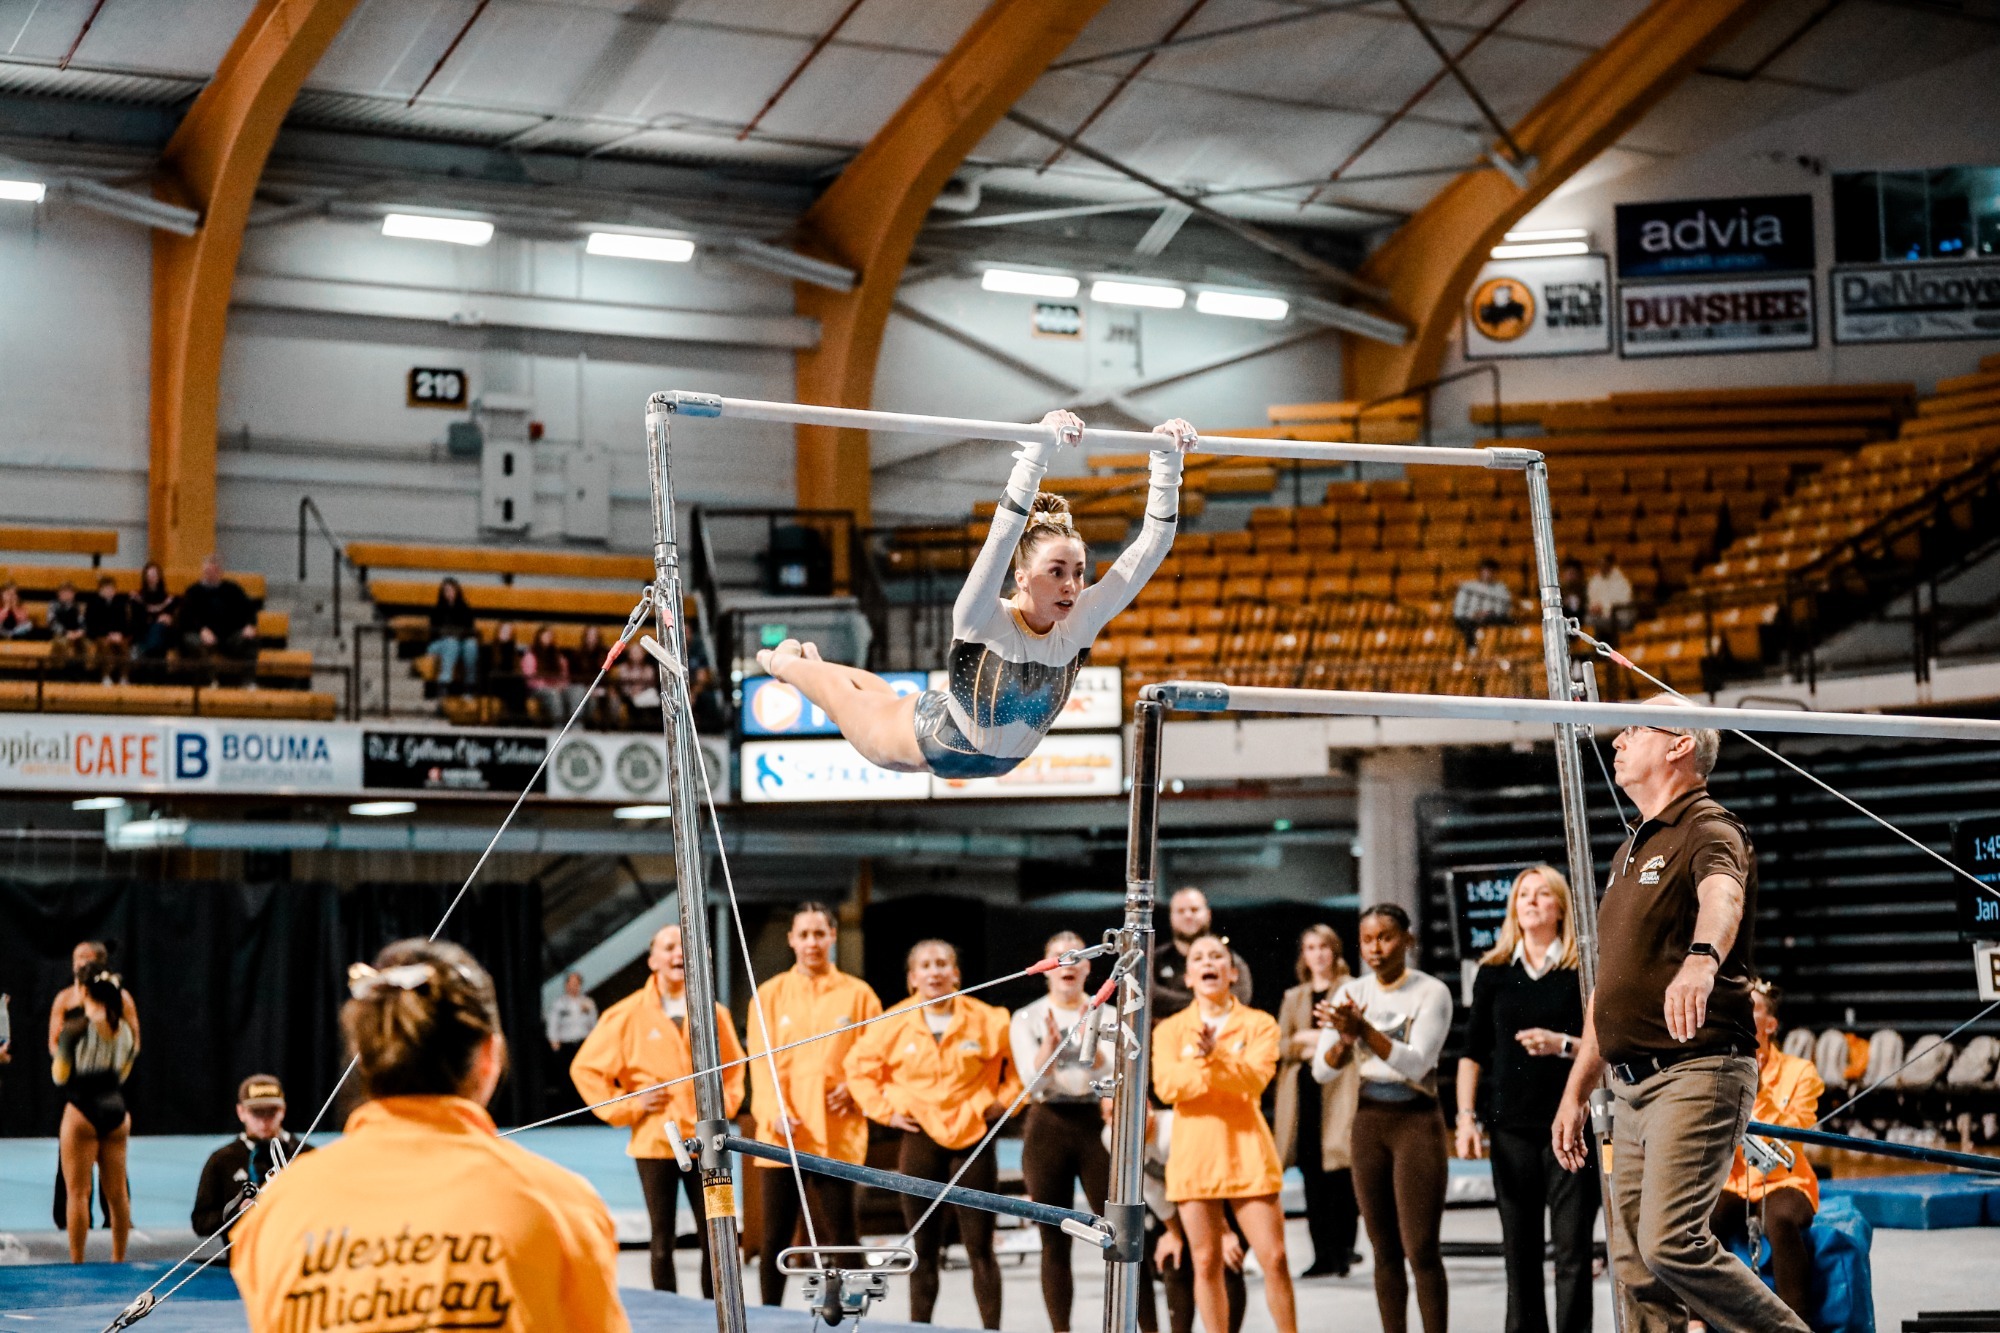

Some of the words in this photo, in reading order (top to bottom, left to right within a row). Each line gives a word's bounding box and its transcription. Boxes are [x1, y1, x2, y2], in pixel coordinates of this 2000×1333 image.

[1640, 207, 1783, 252] advia
[1625, 290, 1806, 329] DUNSHEE
[75, 733, 157, 777] CAFE
[176, 733, 208, 779] B
[222, 734, 331, 761] BOUMA
[1975, 897, 1998, 921] Jan
[703, 1176, 732, 1186] ARNING
[302, 1223, 498, 1277] Western
[279, 1277, 511, 1333] Michigan
